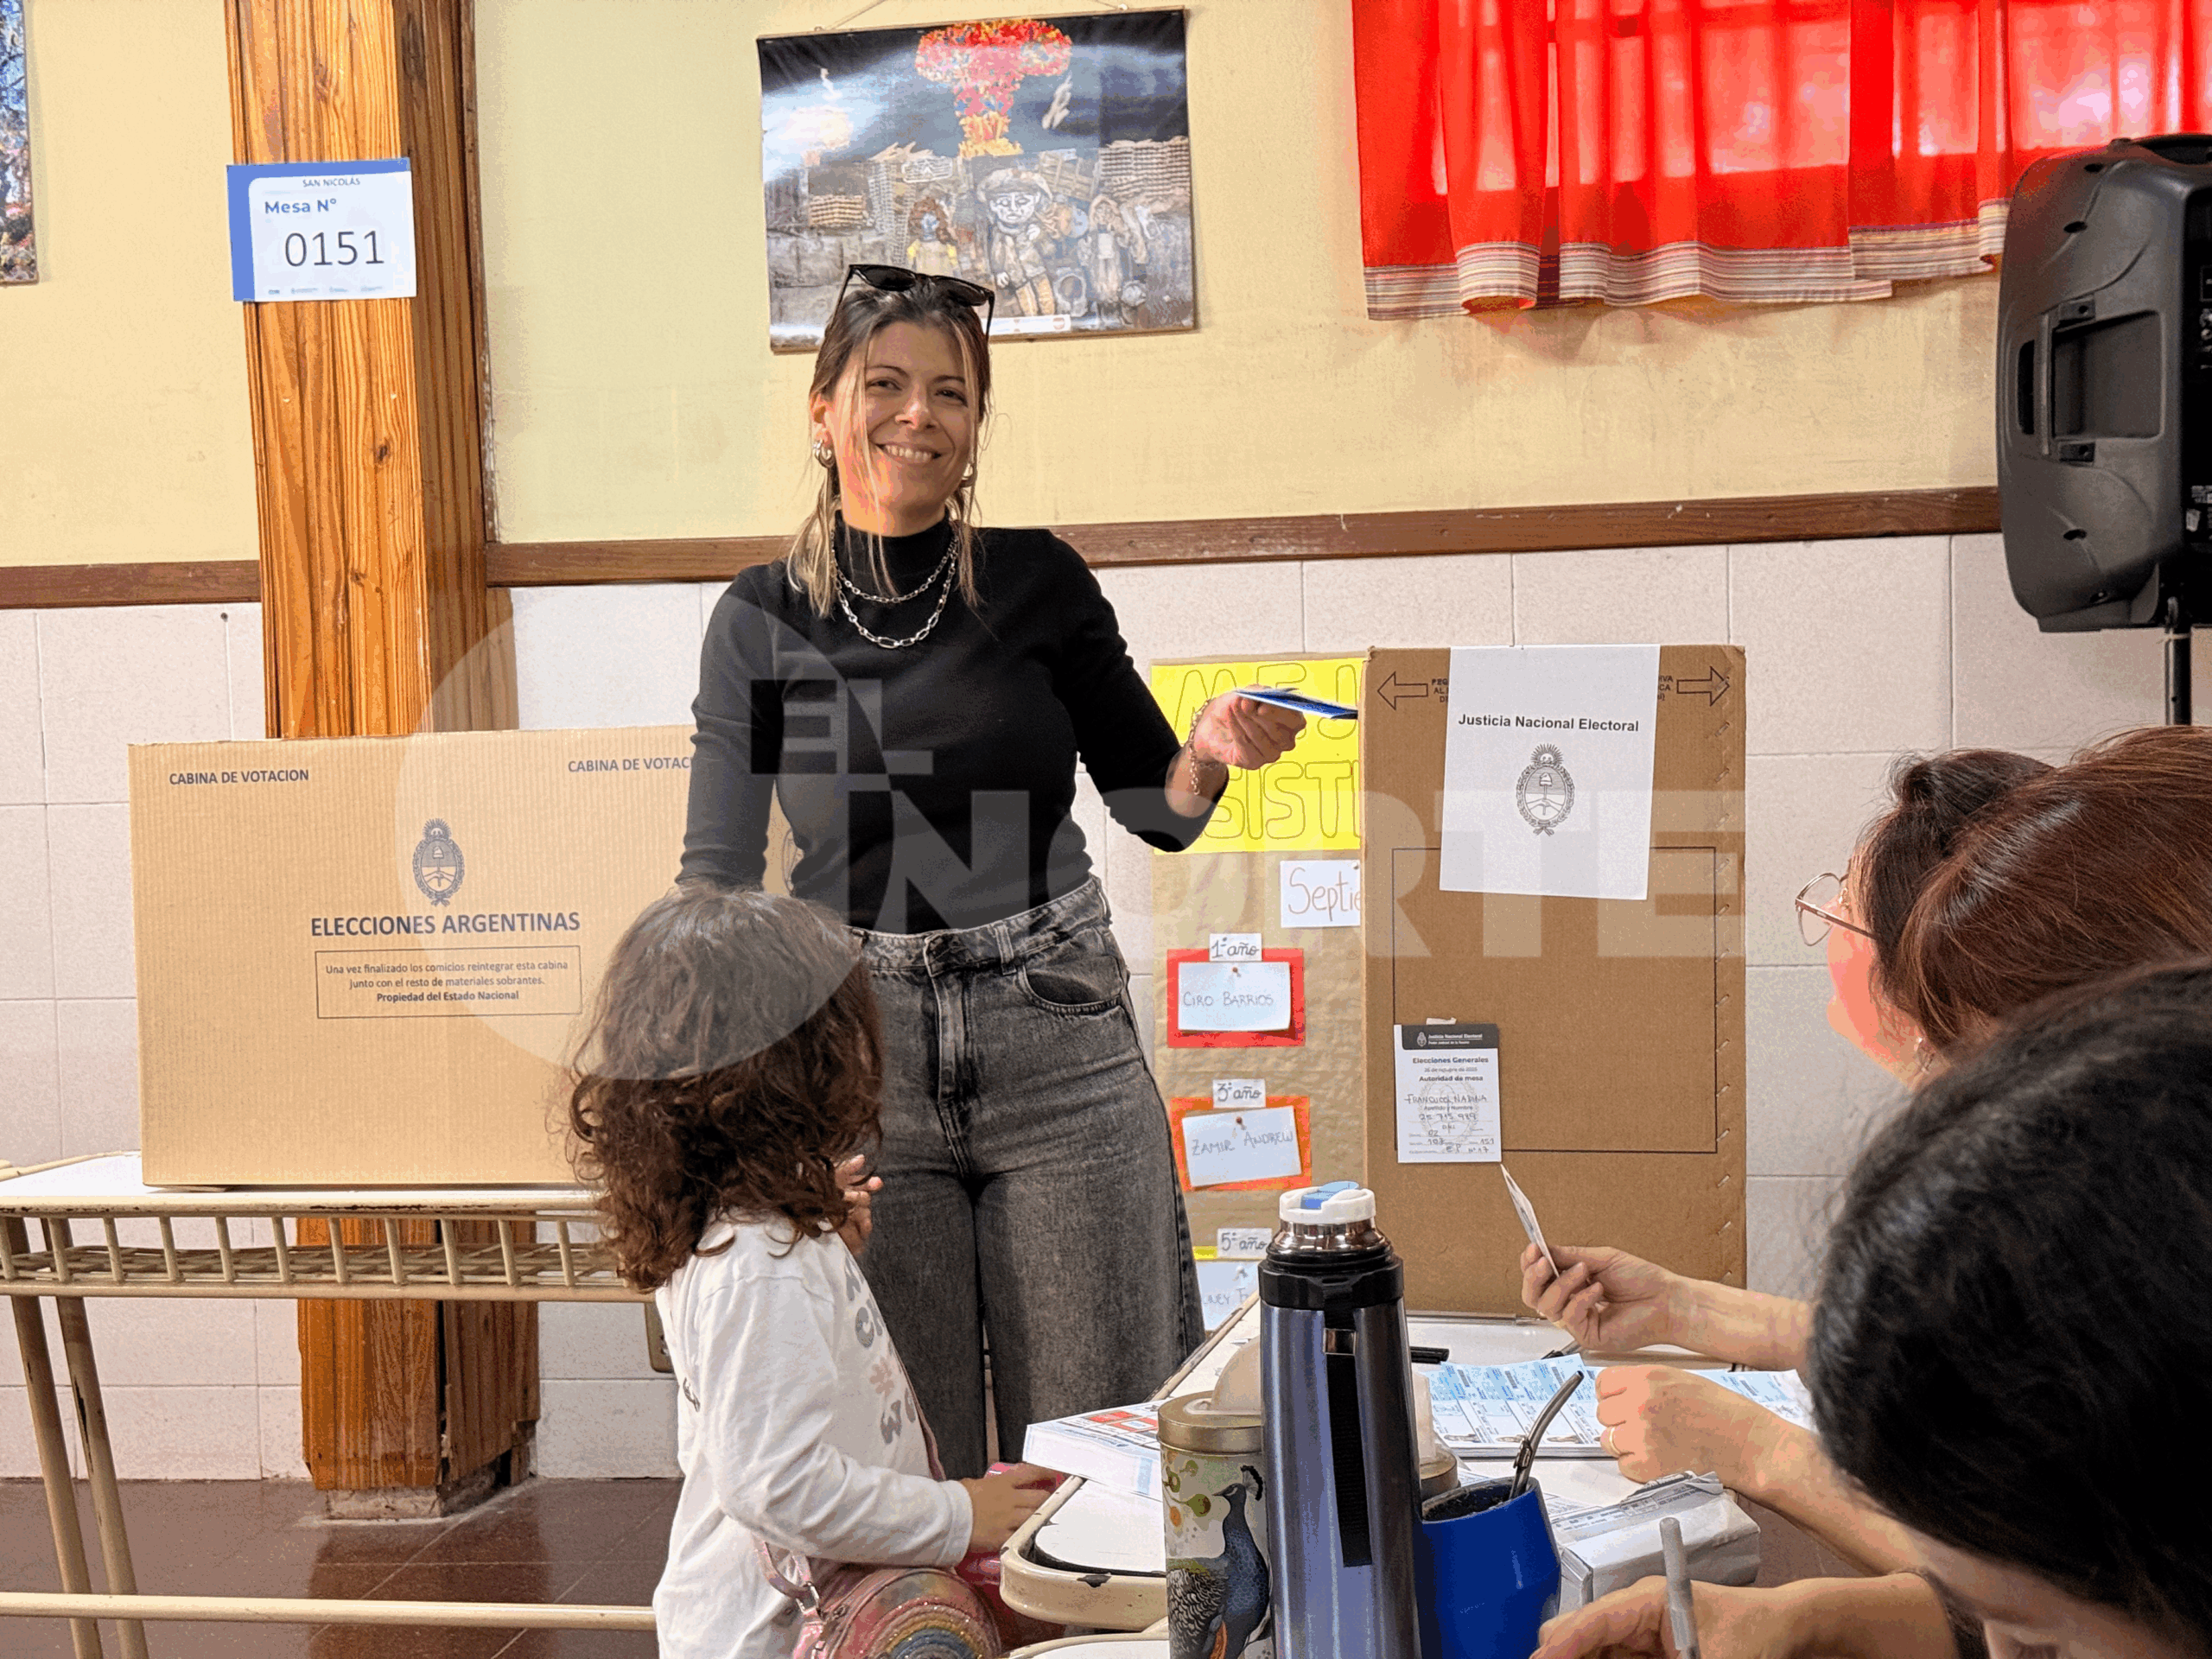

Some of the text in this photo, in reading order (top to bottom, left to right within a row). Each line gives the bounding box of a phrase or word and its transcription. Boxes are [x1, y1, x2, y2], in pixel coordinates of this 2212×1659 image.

[302, 178, 321, 188] SAN
[265, 201, 311, 213] Mesa
[285, 231, 385, 267] 0151
[1459, 714, 1639, 732] Justicia Nacional Electoral
[568, 756, 692, 772] CABINA DE VOTAC
[169, 769, 309, 785] CABINA DE VOTACION
[311, 912, 581, 937] ELECCIONES ARGENTINAS
[1227, 941, 1260, 957] año
[326, 960, 568, 975] Una vez finalizado los comicios reintegrar esta cabina
[349, 976, 545, 990] junto con el resto de materiales sobrantes.
[377, 990, 519, 1003] Propiedad del Estado Nacional
[1183, 991, 1274, 1007] CIRO BARRIOS
[1233, 1086, 1262, 1099] año
[1239, 1236, 1267, 1250] año
